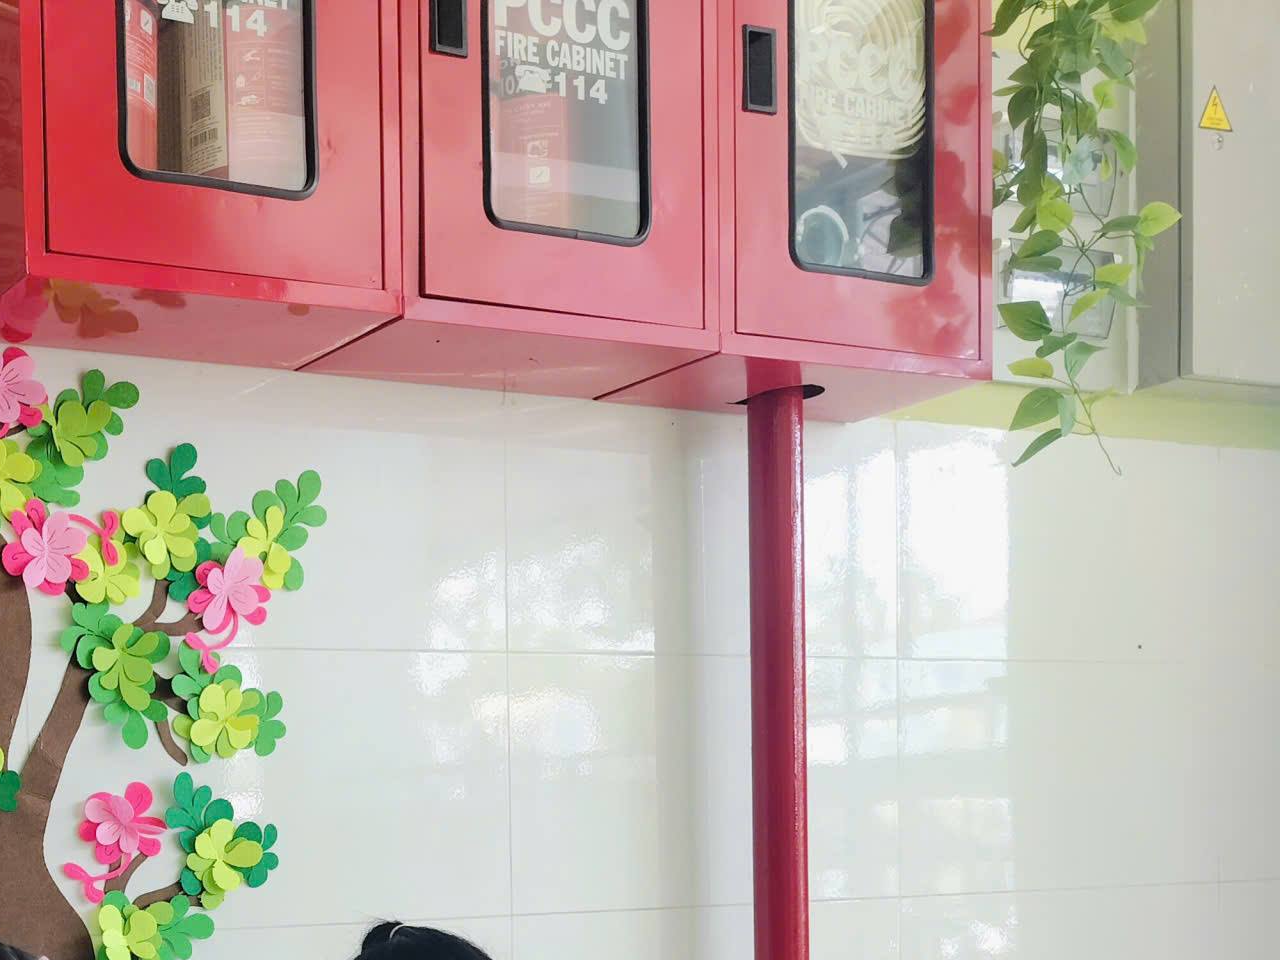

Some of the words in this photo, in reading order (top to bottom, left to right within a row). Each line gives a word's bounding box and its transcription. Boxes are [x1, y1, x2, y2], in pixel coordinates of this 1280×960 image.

[204, 1, 267, 37] 114
[494, 29, 540, 64] FIRE
[546, 39, 628, 80] CABINET
[554, 72, 608, 105] 114
